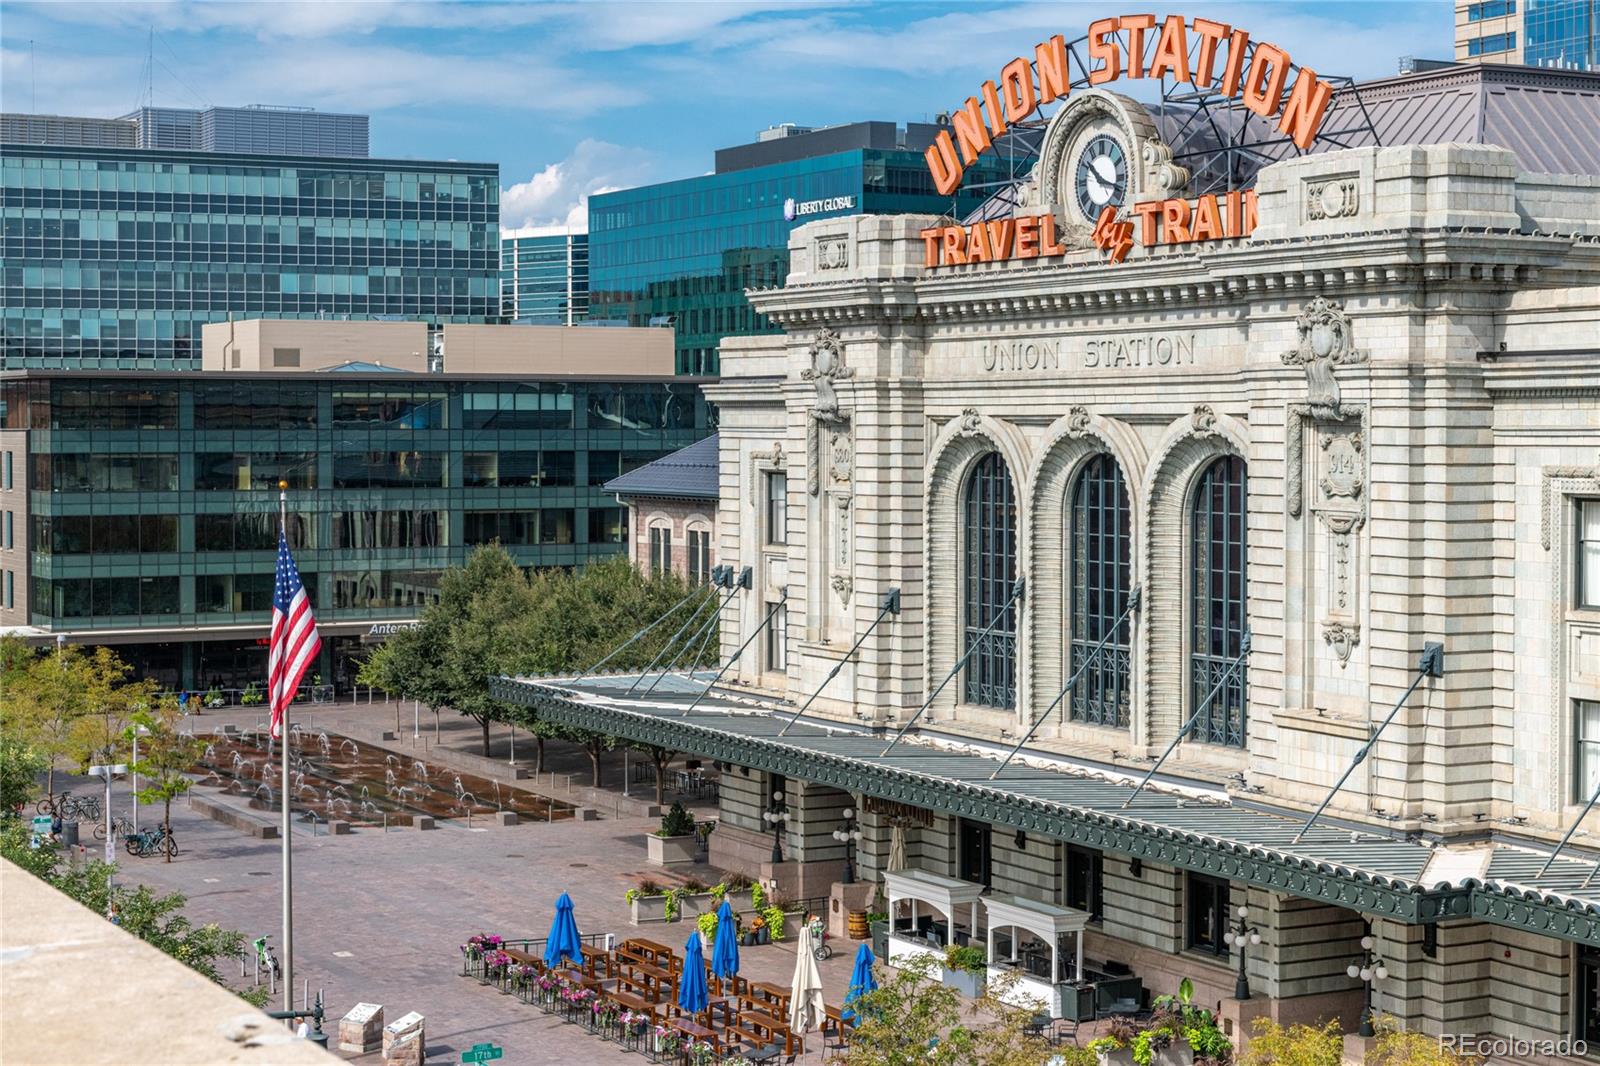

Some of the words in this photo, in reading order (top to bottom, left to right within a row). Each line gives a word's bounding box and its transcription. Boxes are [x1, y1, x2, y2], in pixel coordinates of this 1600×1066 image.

[924, 34, 1071, 196] UNION
[1088, 14, 1333, 149] STATION
[796, 200, 823, 215] LIBERTY
[824, 196, 855, 212] GLOBAL
[920, 213, 1066, 268] TRAVEL
[1091, 205, 1135, 266] by
[983, 341, 1060, 371] UNION
[1084, 334, 1195, 368] STATION
[369, 623, 409, 634] Antero
